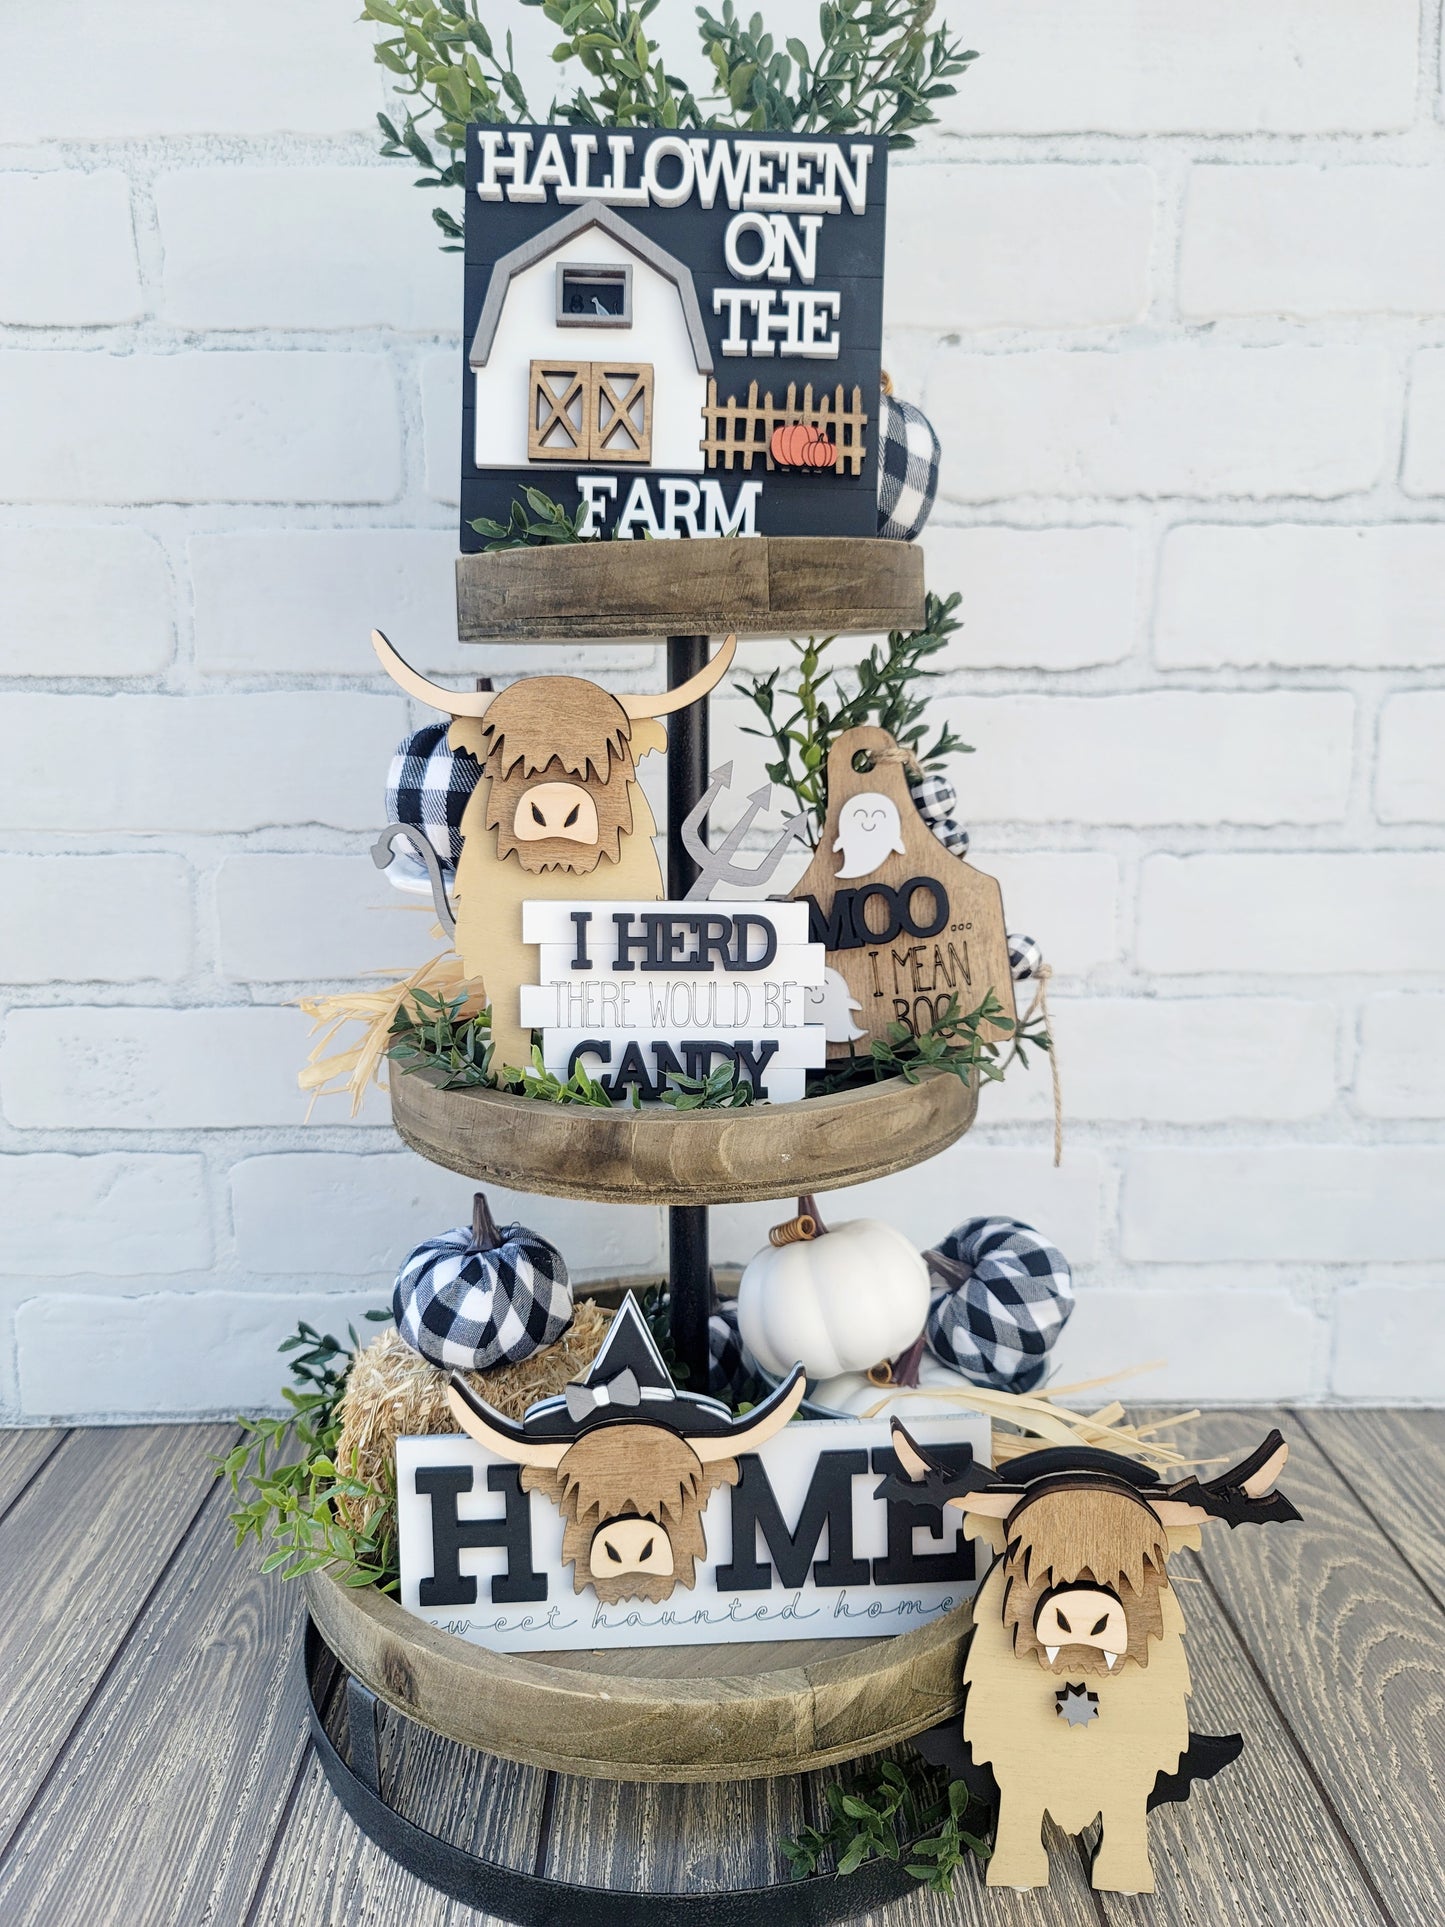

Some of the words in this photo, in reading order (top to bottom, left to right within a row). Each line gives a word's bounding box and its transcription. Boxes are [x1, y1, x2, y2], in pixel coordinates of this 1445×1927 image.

[477, 130, 873, 214] HALLOWEEN
[723, 212, 822, 284] ON
[713, 289, 841, 359] THE
[577, 475, 763, 539] FARM
[570, 911, 593, 970] I
[612, 912, 778, 971] HERD
[868, 951, 884, 997] I
[891, 941, 971, 996] MEAN
[550, 980, 637, 1028] THERE
[649, 980, 752, 1028] WOULD
[763, 980, 798, 1028] BE
[893, 993, 958, 1040] BOO
[568, 1039, 779, 1101] CANDY
[414, 1441, 977, 1607] HME
[592, 1592, 820, 1630] haunted
[833, 1590, 954, 1618] home
